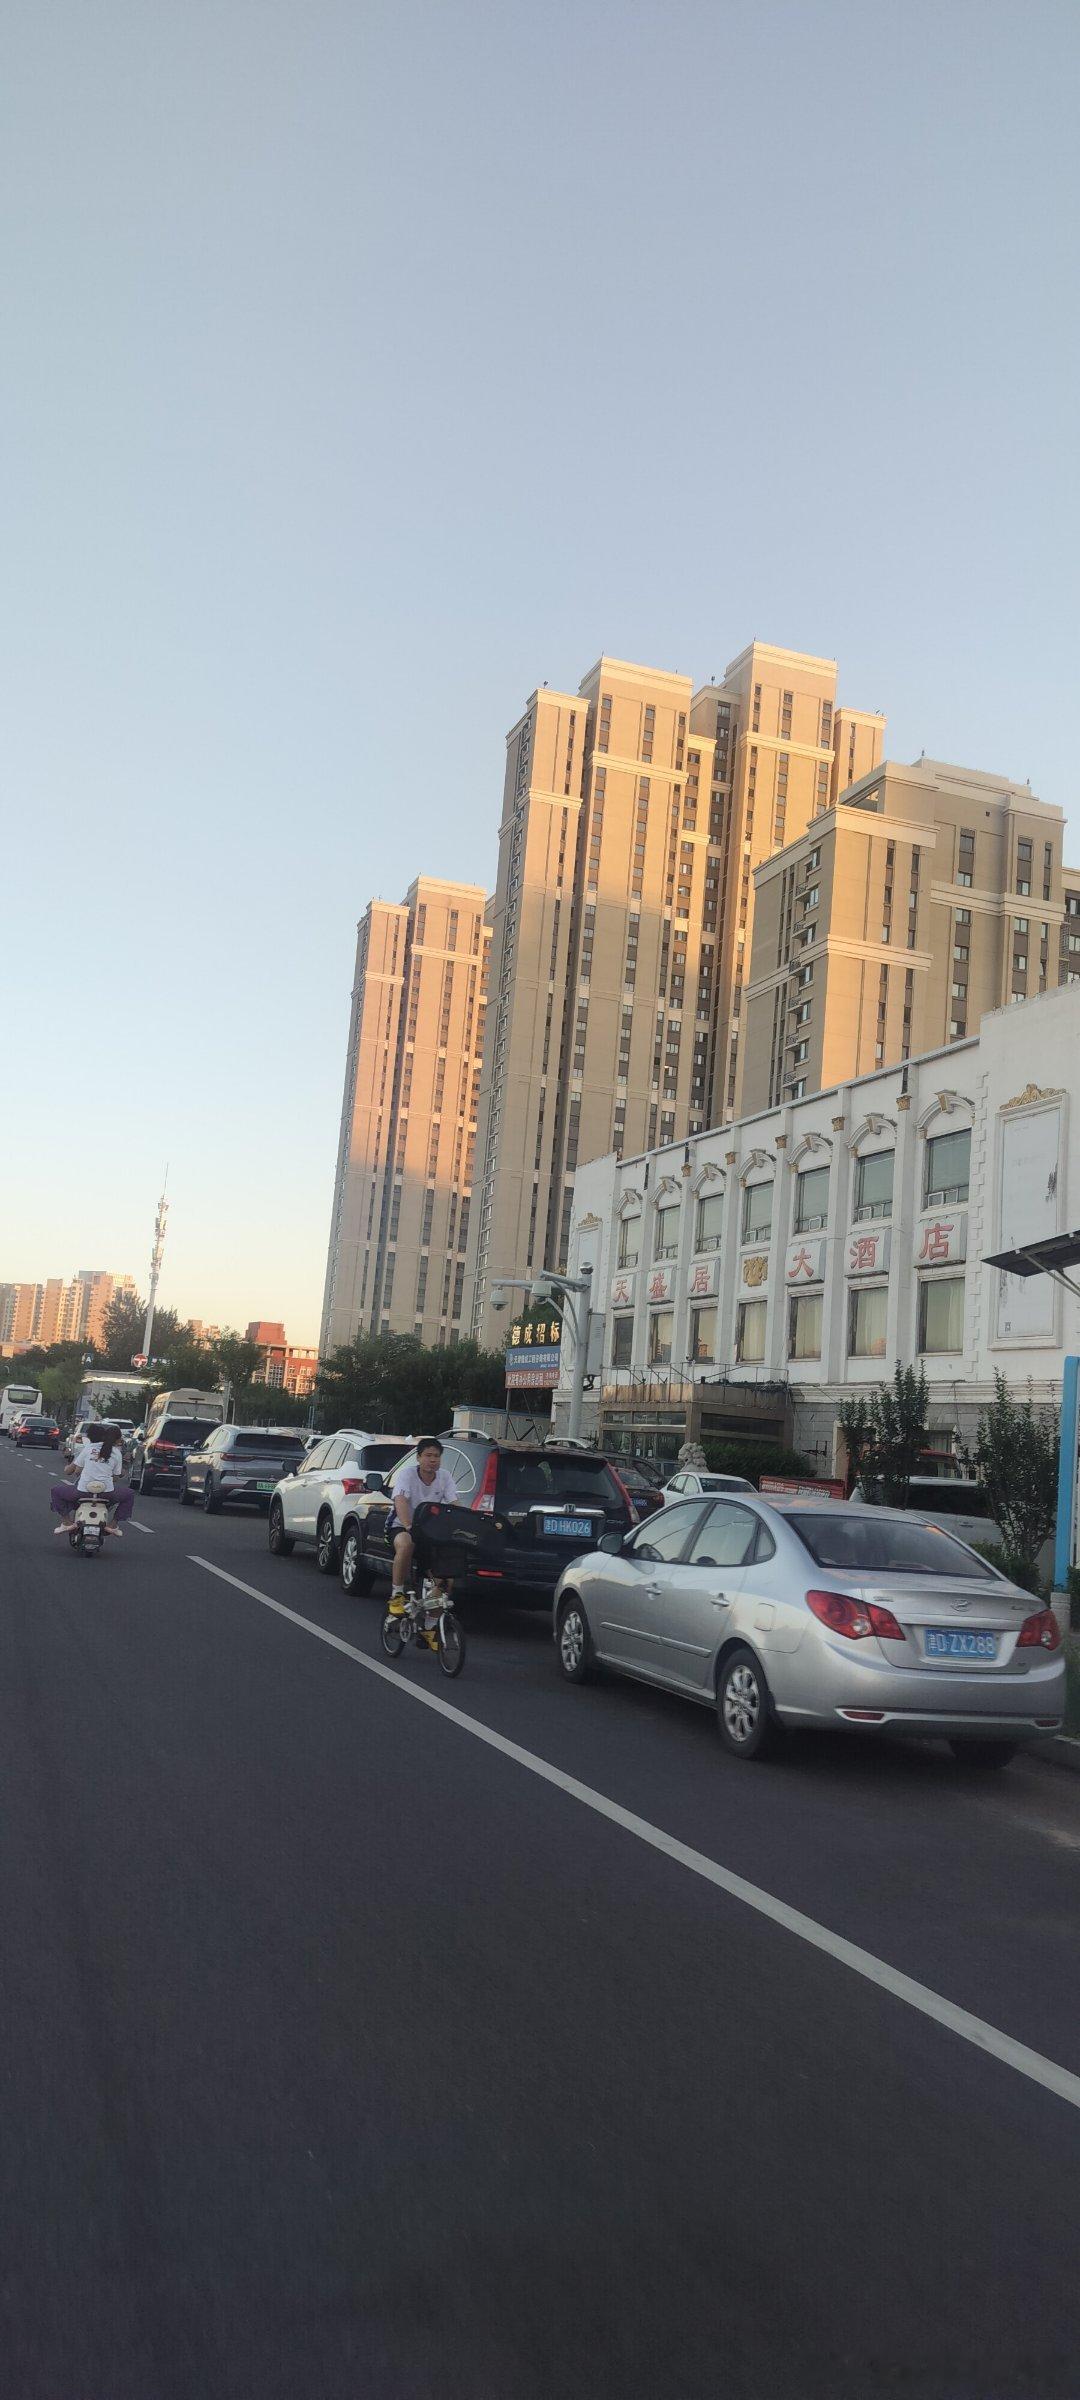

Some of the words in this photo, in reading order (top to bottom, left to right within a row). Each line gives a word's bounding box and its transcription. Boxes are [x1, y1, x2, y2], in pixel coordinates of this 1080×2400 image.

[613, 1262, 711, 1303] 天盛居
[788, 1223, 954, 1279] 大酒店
